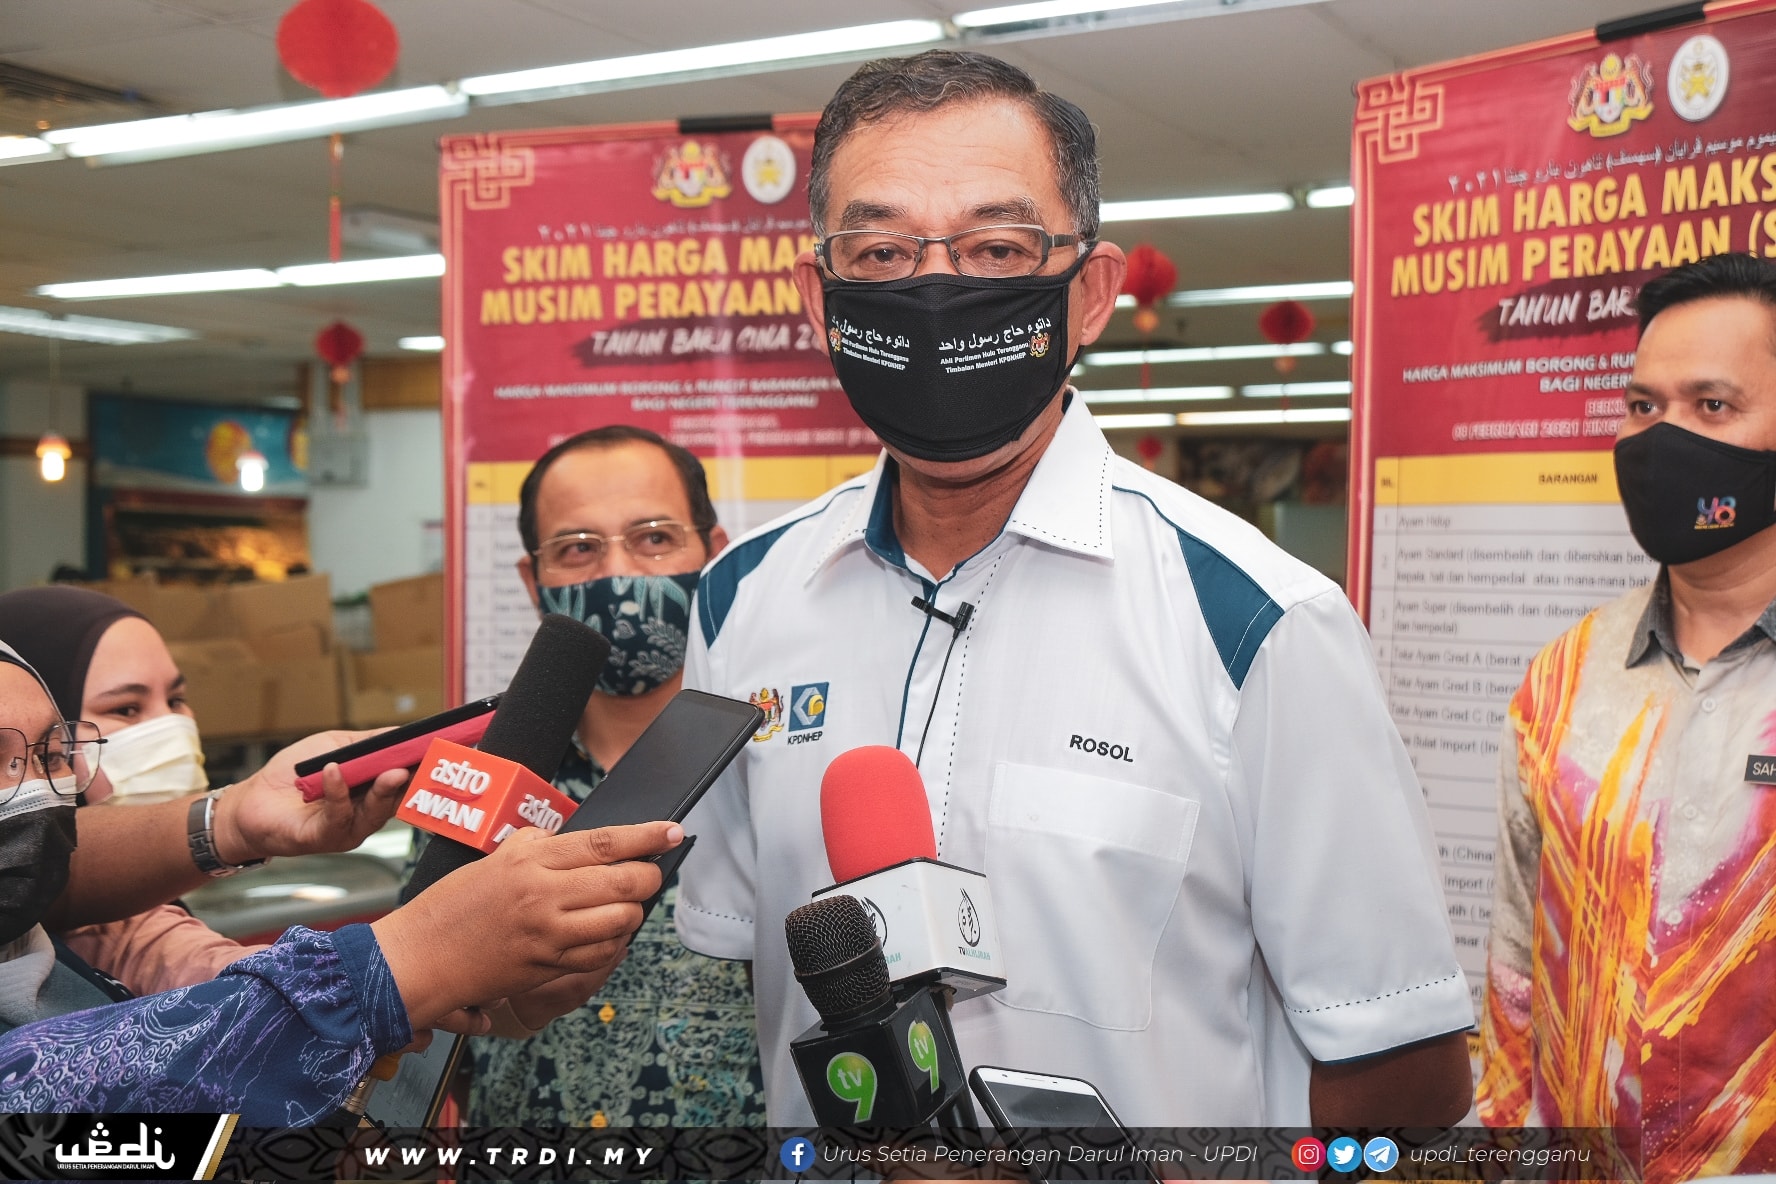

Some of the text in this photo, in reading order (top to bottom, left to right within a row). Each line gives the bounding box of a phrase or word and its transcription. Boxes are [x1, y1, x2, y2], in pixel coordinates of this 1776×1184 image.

[1413, 194, 1500, 247] SKIM
[1513, 173, 1647, 234] HARGA
[503, 244, 592, 283] SKIM
[603, 237, 728, 276] HARGA
[1391, 242, 1508, 297] MUSIM
[1522, 216, 1730, 281] PERAYAAN
[481, 276, 802, 326] MUSIM PERAYAAN
[1499, 286, 1641, 327] TAHUN BAR
[591, 327, 666, 358] TAHUN
[671, 327, 733, 354] BARU
[938, 337, 965, 352] واحد
[968, 332, 1000, 349] رسول
[1003, 325, 1024, 344] حاج
[1403, 365, 1448, 383] HARGA
[1450, 360, 1522, 380] MAKSIMUM
[1525, 354, 1595, 375] BORONG
[1598, 355, 1607, 369] &
[1540, 375, 1580, 393] BAGI
[1469, 419, 1539, 440] FEBRUARI
[1541, 417, 1580, 438] 2021
[1539, 472, 1599, 486] BARANGAN
[1537, 549, 1560, 561] dan
[787, 731, 823, 745] KPDNHEP
[1070, 735, 1133, 763] ROSOL
[430, 758, 492, 795] astro
[405, 788, 486, 833] AWANI
